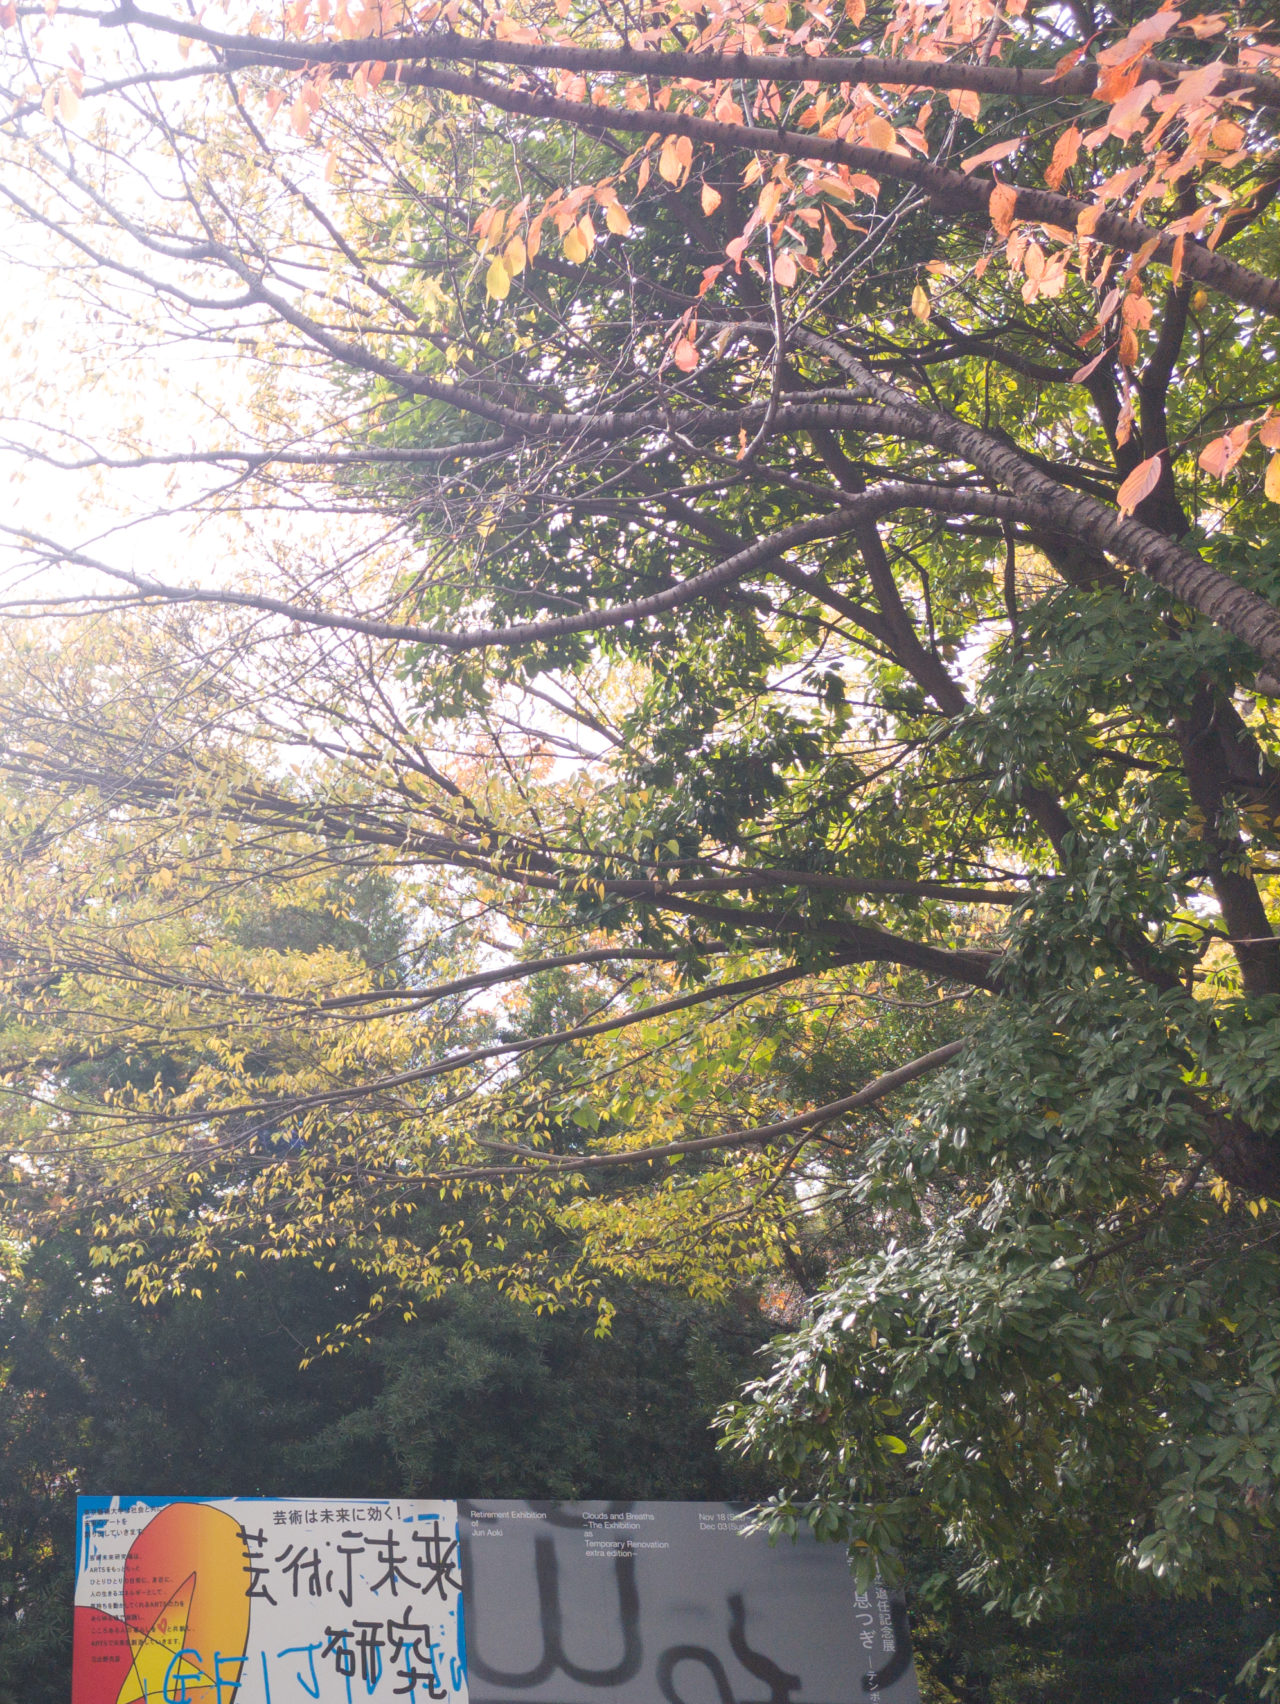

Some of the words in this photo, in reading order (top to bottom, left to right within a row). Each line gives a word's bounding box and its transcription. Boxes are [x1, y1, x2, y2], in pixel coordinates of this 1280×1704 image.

[273, 1505, 402, 1526] 芸術は未来に効く!
[470, 1510, 509, 1519] Retirement
[511, 1510, 547, 1519] Exhibition
[582, 1511, 608, 1520] Clouds
[609, 1512, 624, 1520] and
[626, 1512, 655, 1521] Breaths
[698, 1513, 714, 1521] Nov
[717, 1513, 726, 1521] 18
[604, 1521, 641, 1530] Exhibition
[699, 1522, 716, 1530] Dec
[472, 1528, 486, 1537] Jun
[487, 1528, 504, 1537] Aoki
[585, 1539, 625, 1550] Temporary
[627, 1540, 670, 1549] Renovation
[586, 1549, 605, 1558] extra
